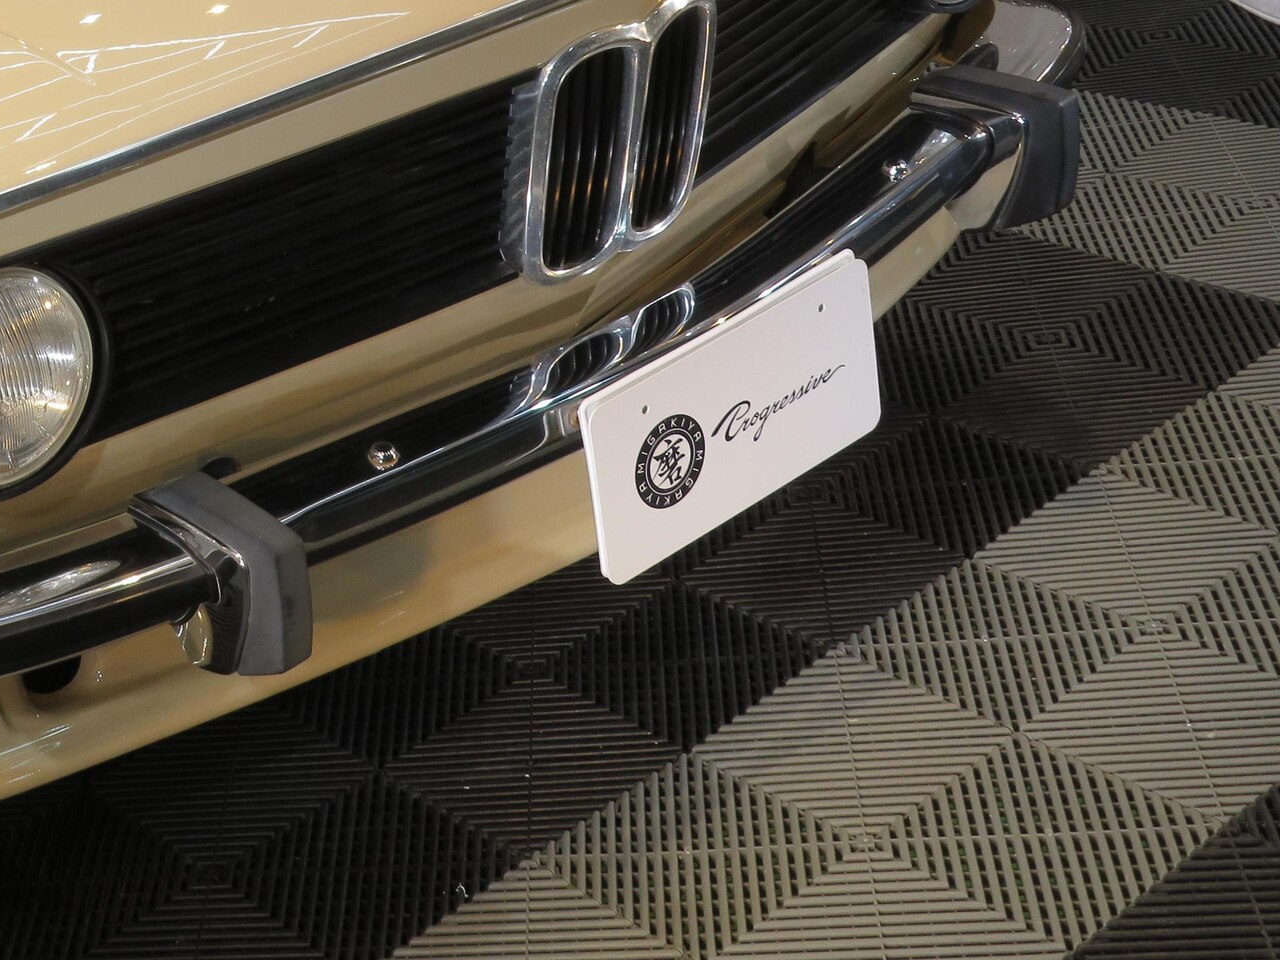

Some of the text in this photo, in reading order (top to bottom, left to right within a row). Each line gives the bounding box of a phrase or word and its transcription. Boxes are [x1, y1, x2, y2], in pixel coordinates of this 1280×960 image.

[711, 364, 845, 442] Progressive
[637, 417, 702, 474] MIGAKIYA
[652, 438, 686, 487] 磨
[639, 449, 704, 506] MIGAKIYA
